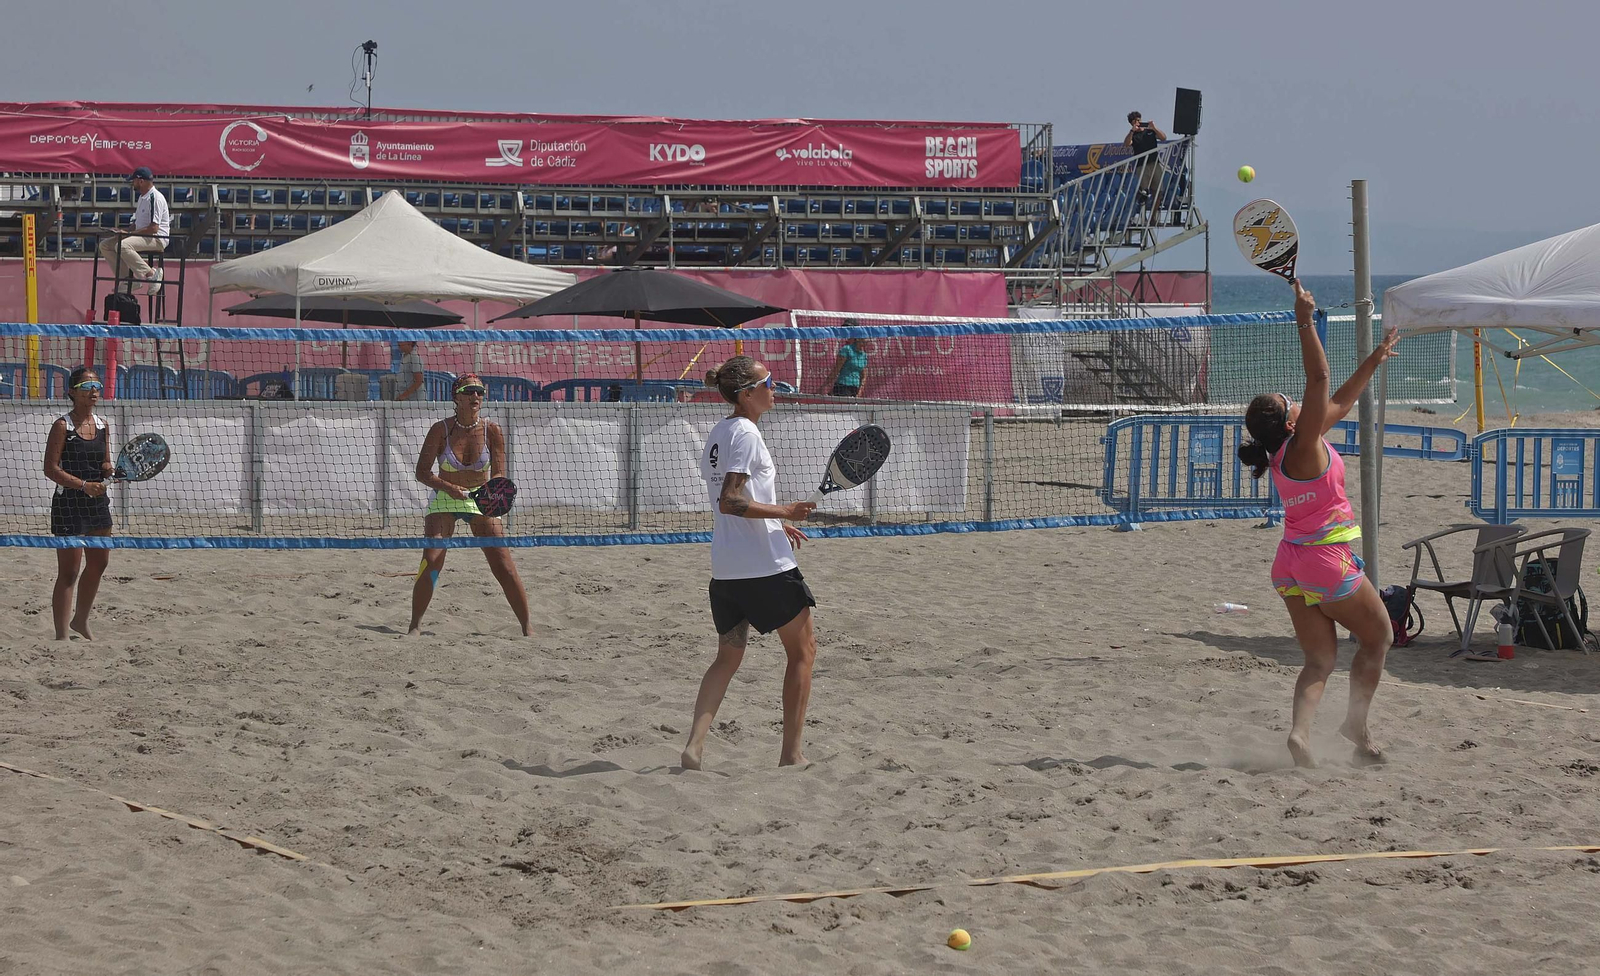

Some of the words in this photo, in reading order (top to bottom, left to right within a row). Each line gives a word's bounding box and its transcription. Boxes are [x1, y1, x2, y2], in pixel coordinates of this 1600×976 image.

[228, 139, 260, 147] VICTORIA
[376, 141, 435, 152] Ayuntamiento
[530, 139, 587, 153] Diputación
[925, 136, 977, 158] BEACH
[376, 152, 387, 160] de
[388, 152, 399, 161] La
[399, 152, 423, 161] Línea
[649, 143, 706, 162] KYDO
[792, 142, 853, 160] volabola
[530, 156, 544, 167] de
[547, 155, 577, 168] Cádiz
[796, 159, 814, 167] vive
[817, 159, 826, 167] tu
[829, 160, 853, 169] voley
[925, 158, 978, 179] SPORTS
[318, 277, 353, 286] DIVINA
